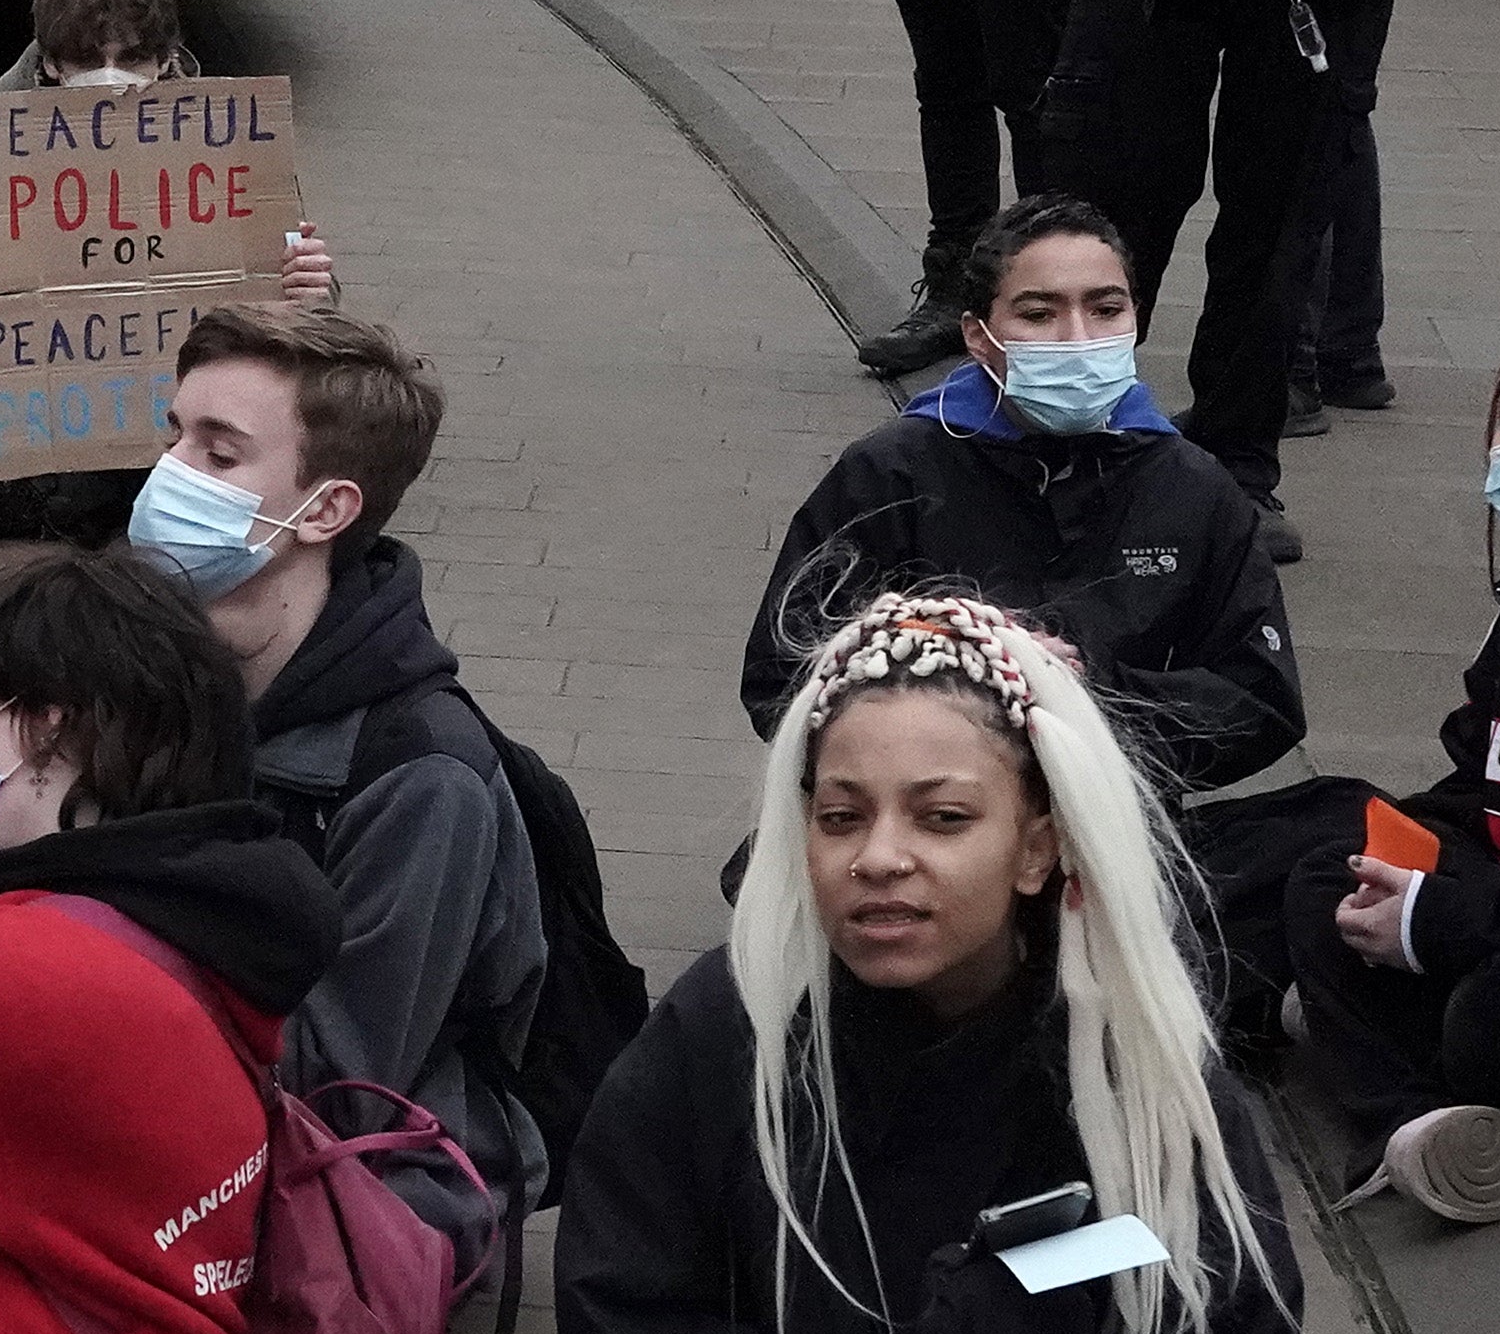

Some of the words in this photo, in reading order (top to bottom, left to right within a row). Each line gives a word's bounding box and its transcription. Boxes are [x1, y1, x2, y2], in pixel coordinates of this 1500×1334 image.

[8, 162, 254, 240] POLICE
[81, 234, 166, 268] FOR
[1121, 547, 1179, 555] MOUNTAIN
